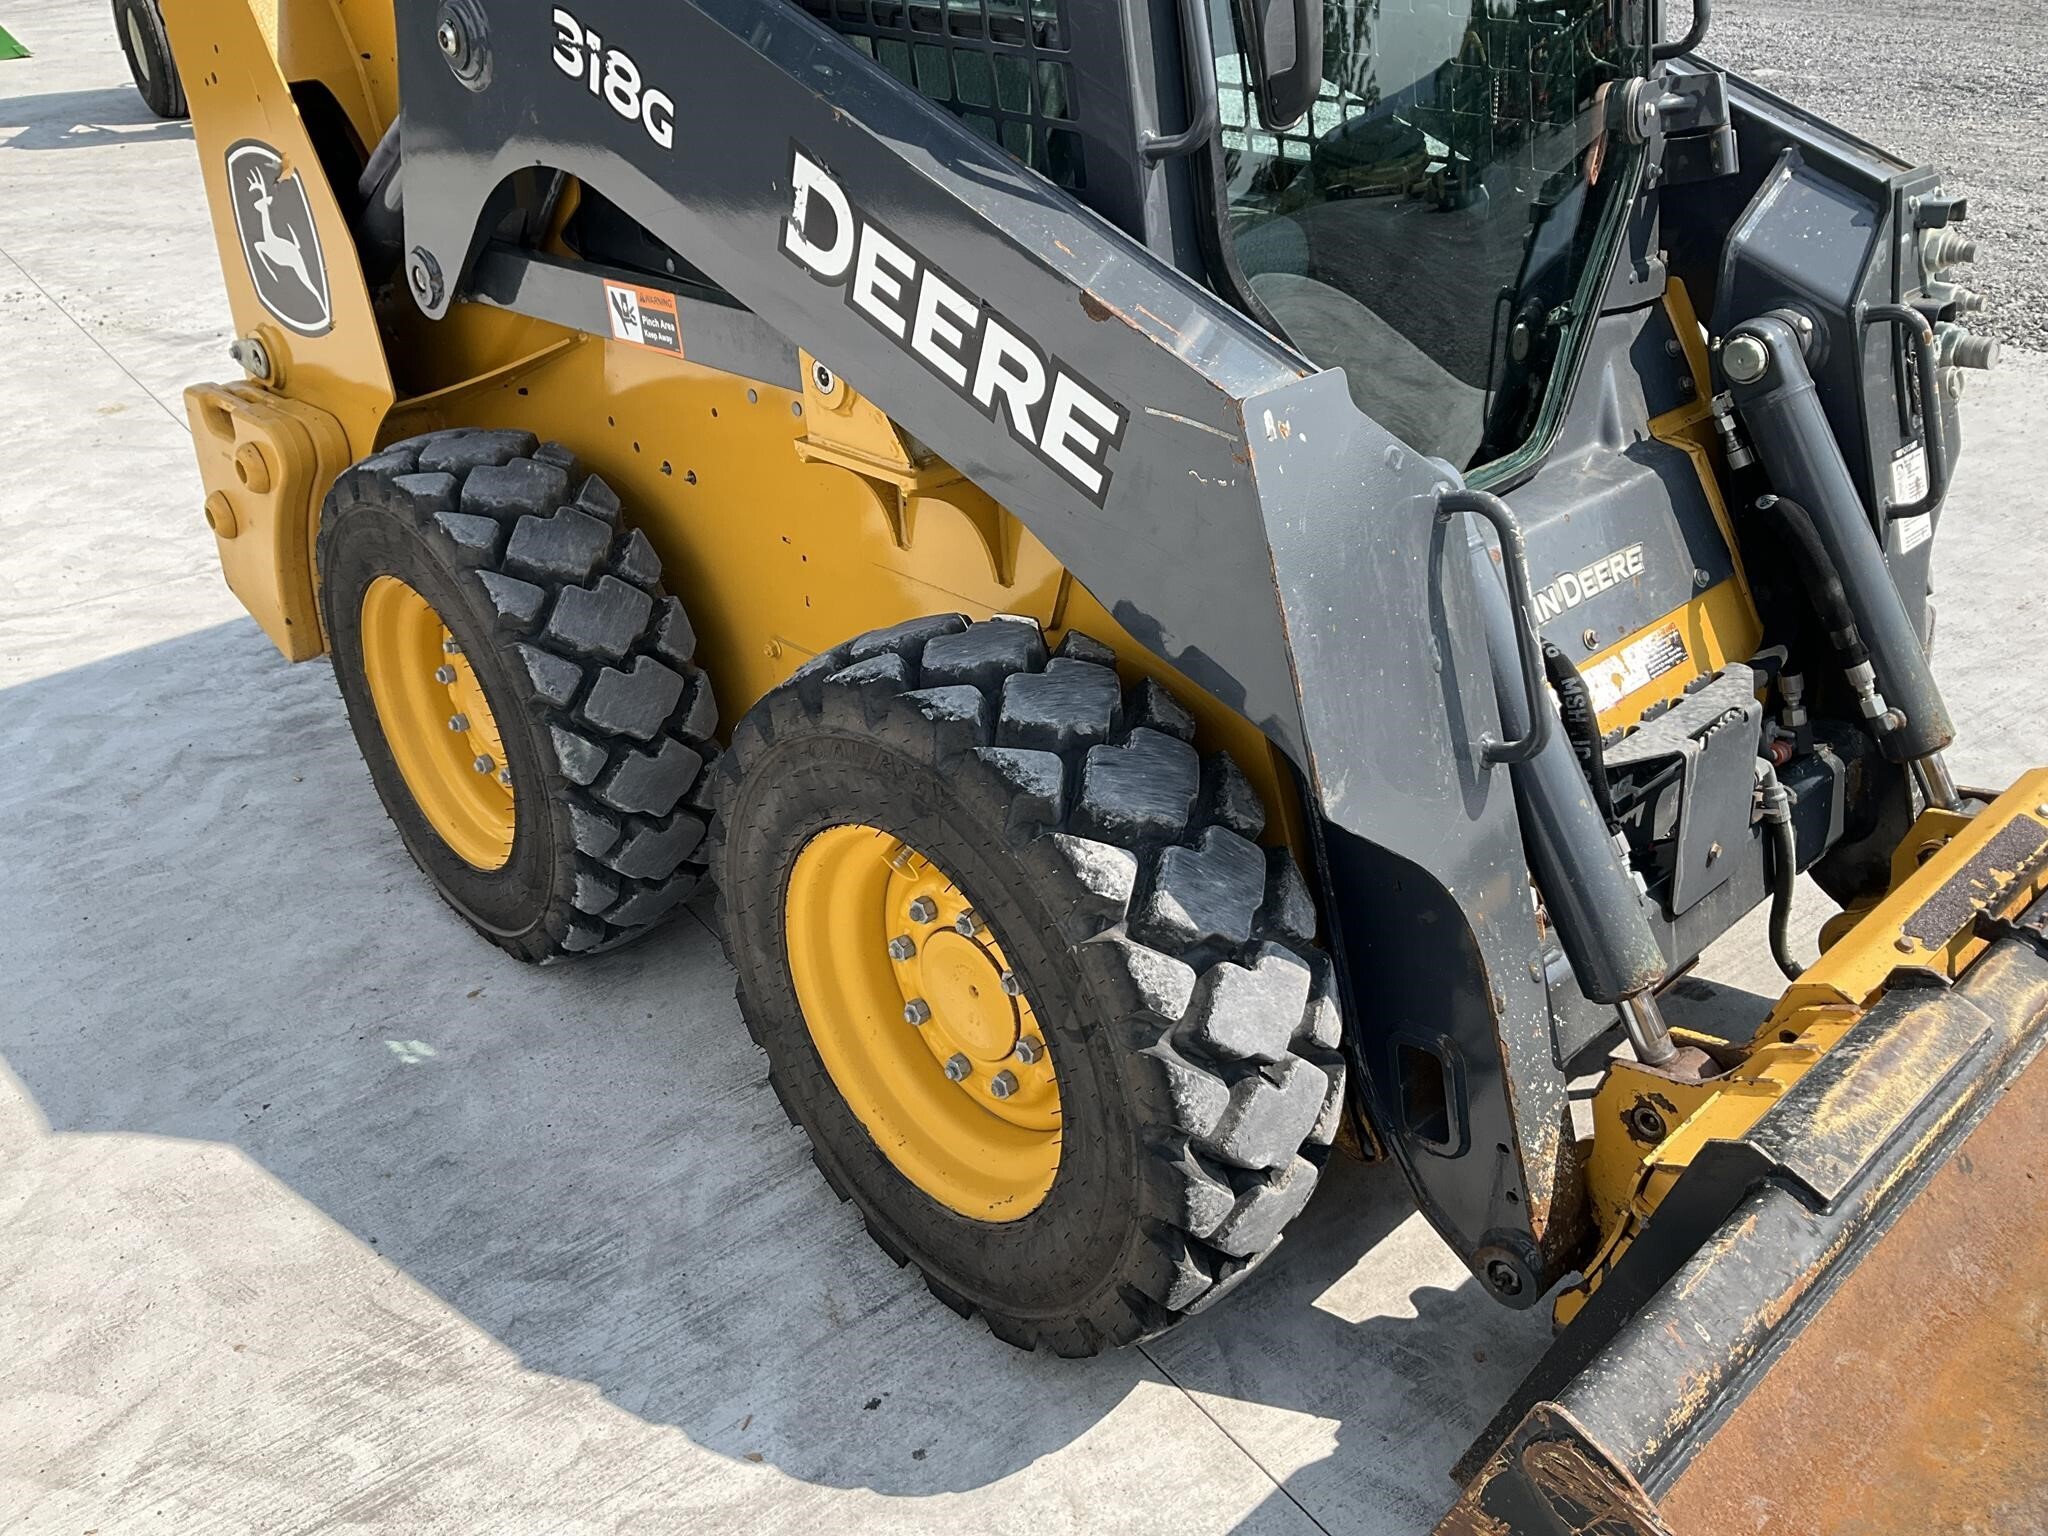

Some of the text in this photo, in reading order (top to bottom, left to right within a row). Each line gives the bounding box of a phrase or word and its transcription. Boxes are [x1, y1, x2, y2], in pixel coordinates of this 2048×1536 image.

[552, 8, 674, 149] 318G
[645, 296, 673, 309] WARNING
[641, 315, 675, 332] Pinch Area
[643, 329, 673, 345] Keep Away
[785, 151, 1120, 495] DEERE
[1557, 545, 1642, 609] DEERE
